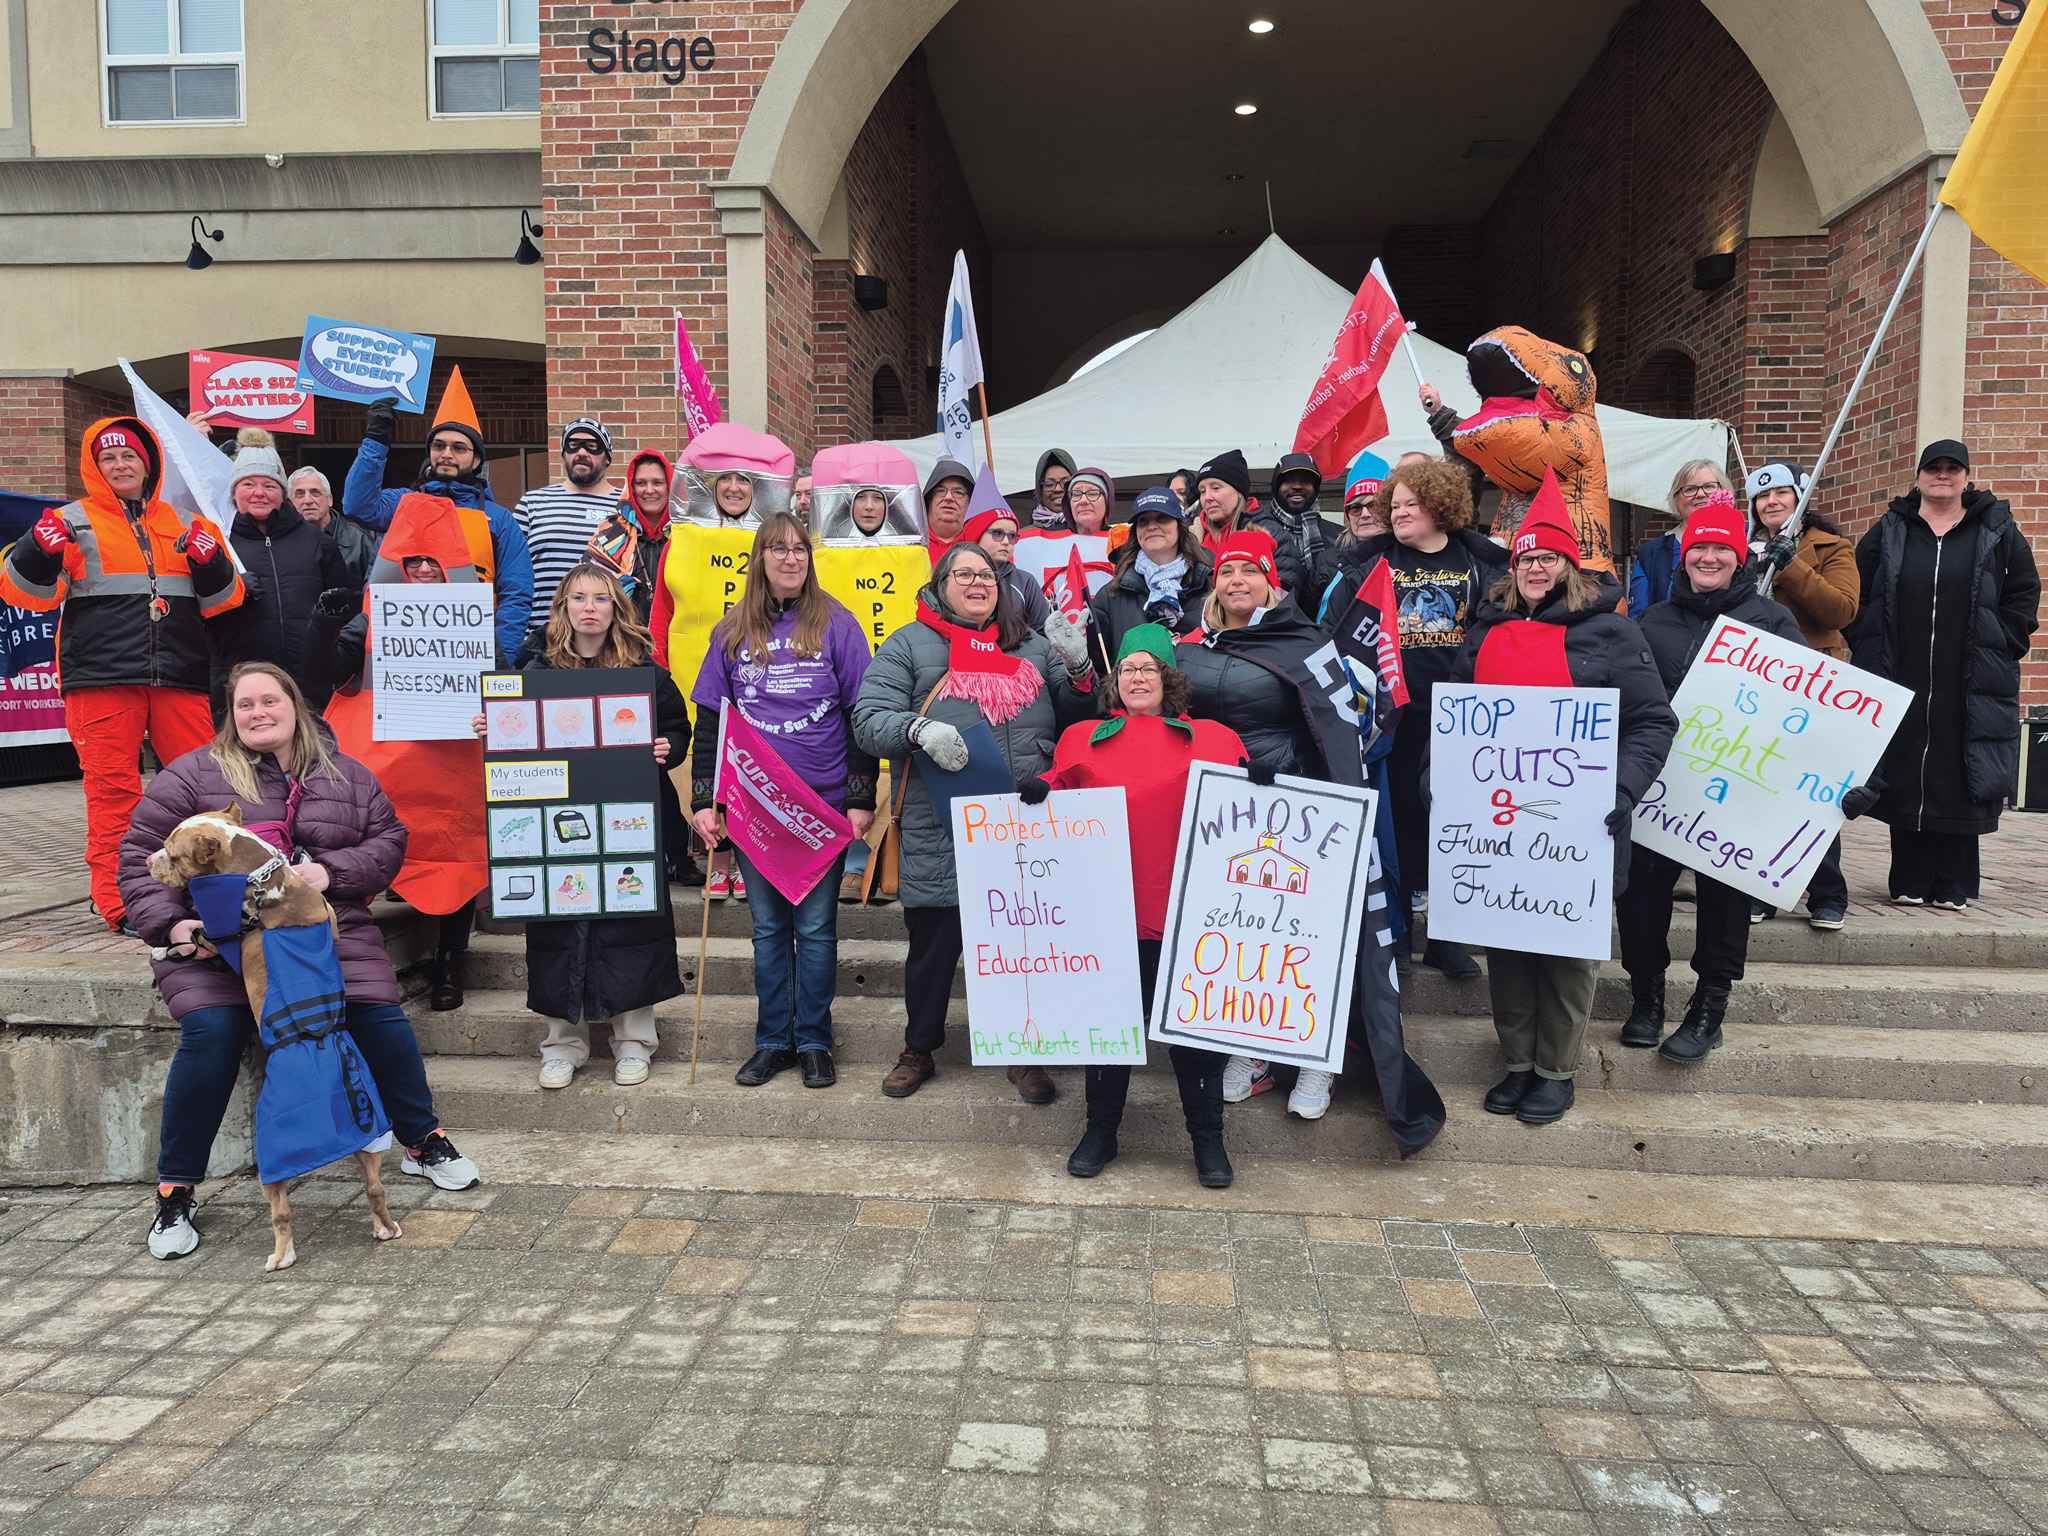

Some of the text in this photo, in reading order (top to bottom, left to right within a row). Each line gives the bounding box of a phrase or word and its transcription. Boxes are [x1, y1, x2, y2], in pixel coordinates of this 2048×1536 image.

[587, 27, 715, 85] Stage
[326, 330, 411, 356] SUPPORT
[337, 346, 397, 367] EVERY
[202, 377, 264, 390] CLASS
[267, 376, 297, 389] SIZ
[322, 357, 406, 383] STUDENT
[214, 392, 302, 407] MATTERS
[690, 404, 711, 433] SCF
[100, 432, 126, 448] ETFO
[1354, 481, 1378, 496] ETFO
[1516, 533, 1537, 554] ETFO
[711, 552, 750, 575] NO. 2
[1392, 567, 1471, 582] The Tortured
[856, 571, 896, 595] NO. 2
[382, 601, 493, 628] PSYCHO-
[381, 636, 494, 660] EDUCATIONAL
[970, 638, 995, 652] ETFO
[10, 673, 39, 691] WE
[383, 671, 482, 694] ASSESSMEN
[493, 680, 519, 691] feel:
[1703, 624, 1883, 728] Education
[783, 717, 809, 734] Sur
[809, 698, 832, 723] Moi
[1436, 695, 1613, 743] STOP THE
[1733, 682, 1811, 735] is a
[618, 737, 637, 745] Angry
[1675, 704, 1854, 810] Right not
[490, 766, 565, 782] My students
[491, 786, 526, 797] need:
[734, 749, 837, 840] CUPE SCFP
[1703, 776, 1729, 804] a
[786, 820, 818, 848] Ontario
[963, 799, 1106, 843] Protection
[1200, 797, 1349, 860] WHOSE
[1637, 780, 1827, 888] Privilege!!
[1437, 822, 1588, 862] Fund Our
[1015, 843, 1059, 878] for
[1451, 864, 1596, 923] Future!
[567, 905, 592, 913] Support
[987, 889, 1066, 927] Public
[1204, 892, 1319, 939] schools...
[976, 942, 1100, 976] Education
[1194, 931, 1311, 989] OUR
[1177, 973, 1317, 1041] SCHOOLS
[973, 1027, 1142, 1056] Put Students First!
